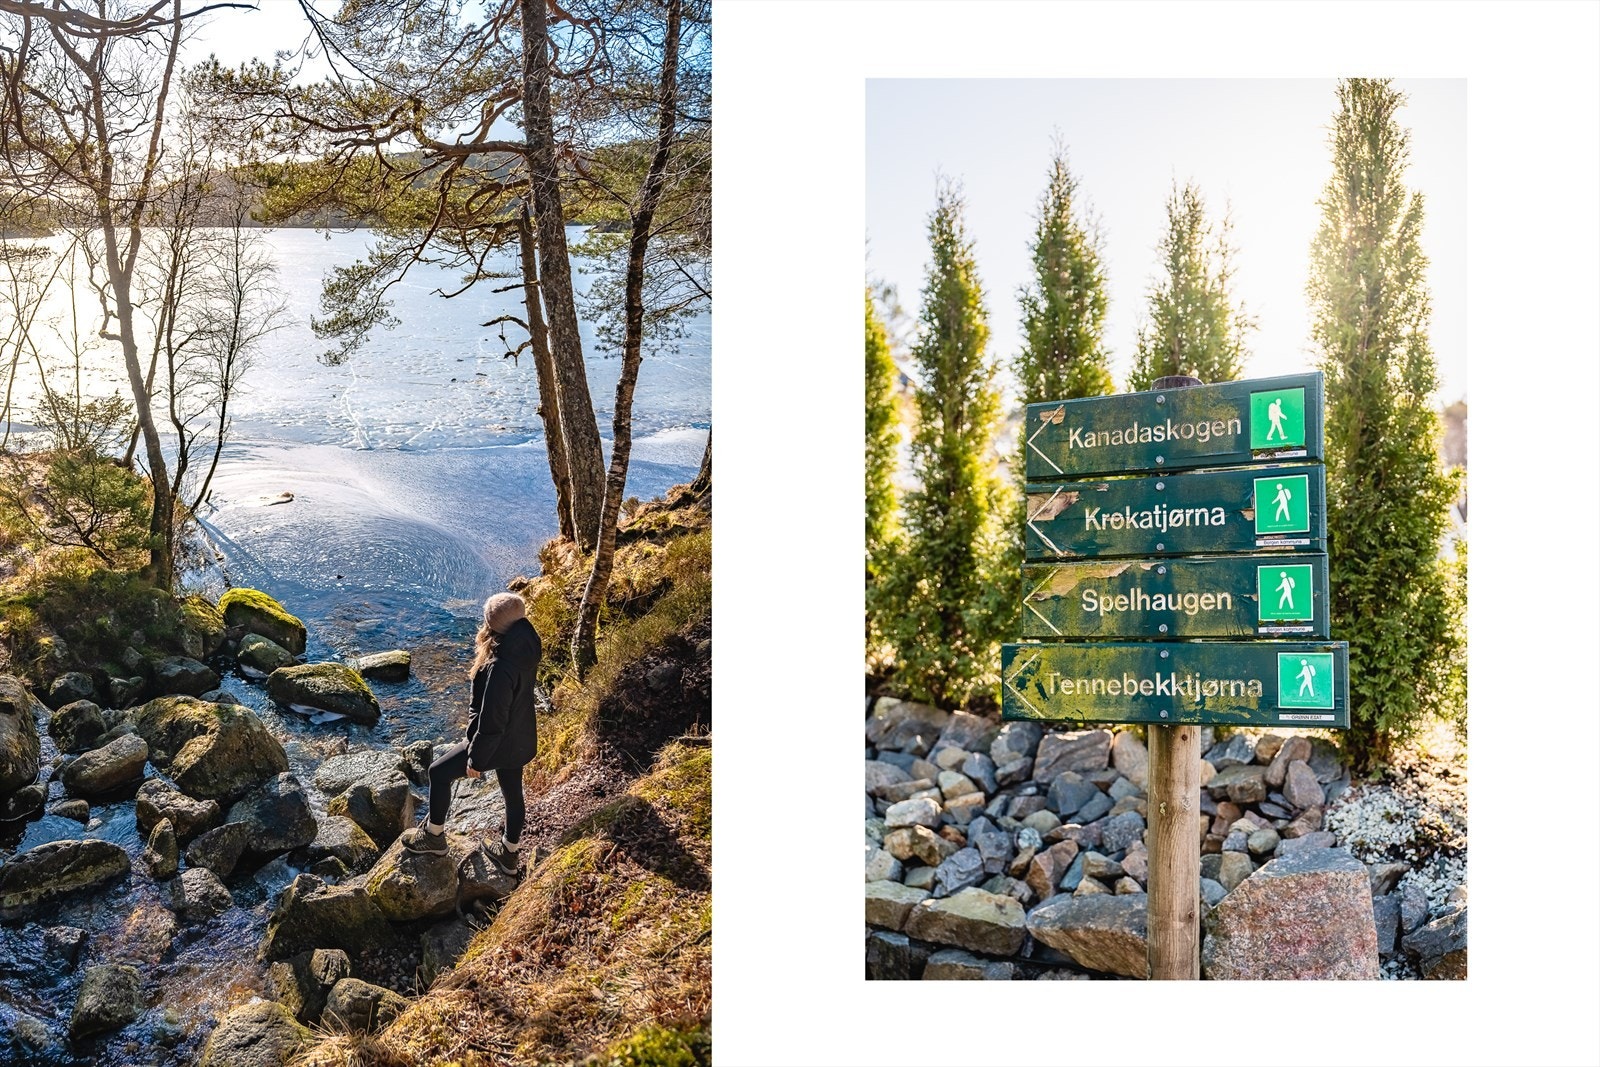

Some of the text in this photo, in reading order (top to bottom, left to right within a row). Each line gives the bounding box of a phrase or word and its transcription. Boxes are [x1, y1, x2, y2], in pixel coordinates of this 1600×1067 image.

[1069, 416, 1242, 450] Kanadaskogen
[1084, 506, 1226, 533] Krokatjørna
[1081, 587, 1232, 616] Spelhaugen
[1045, 672, 1263, 702] Tennebekktjørna
